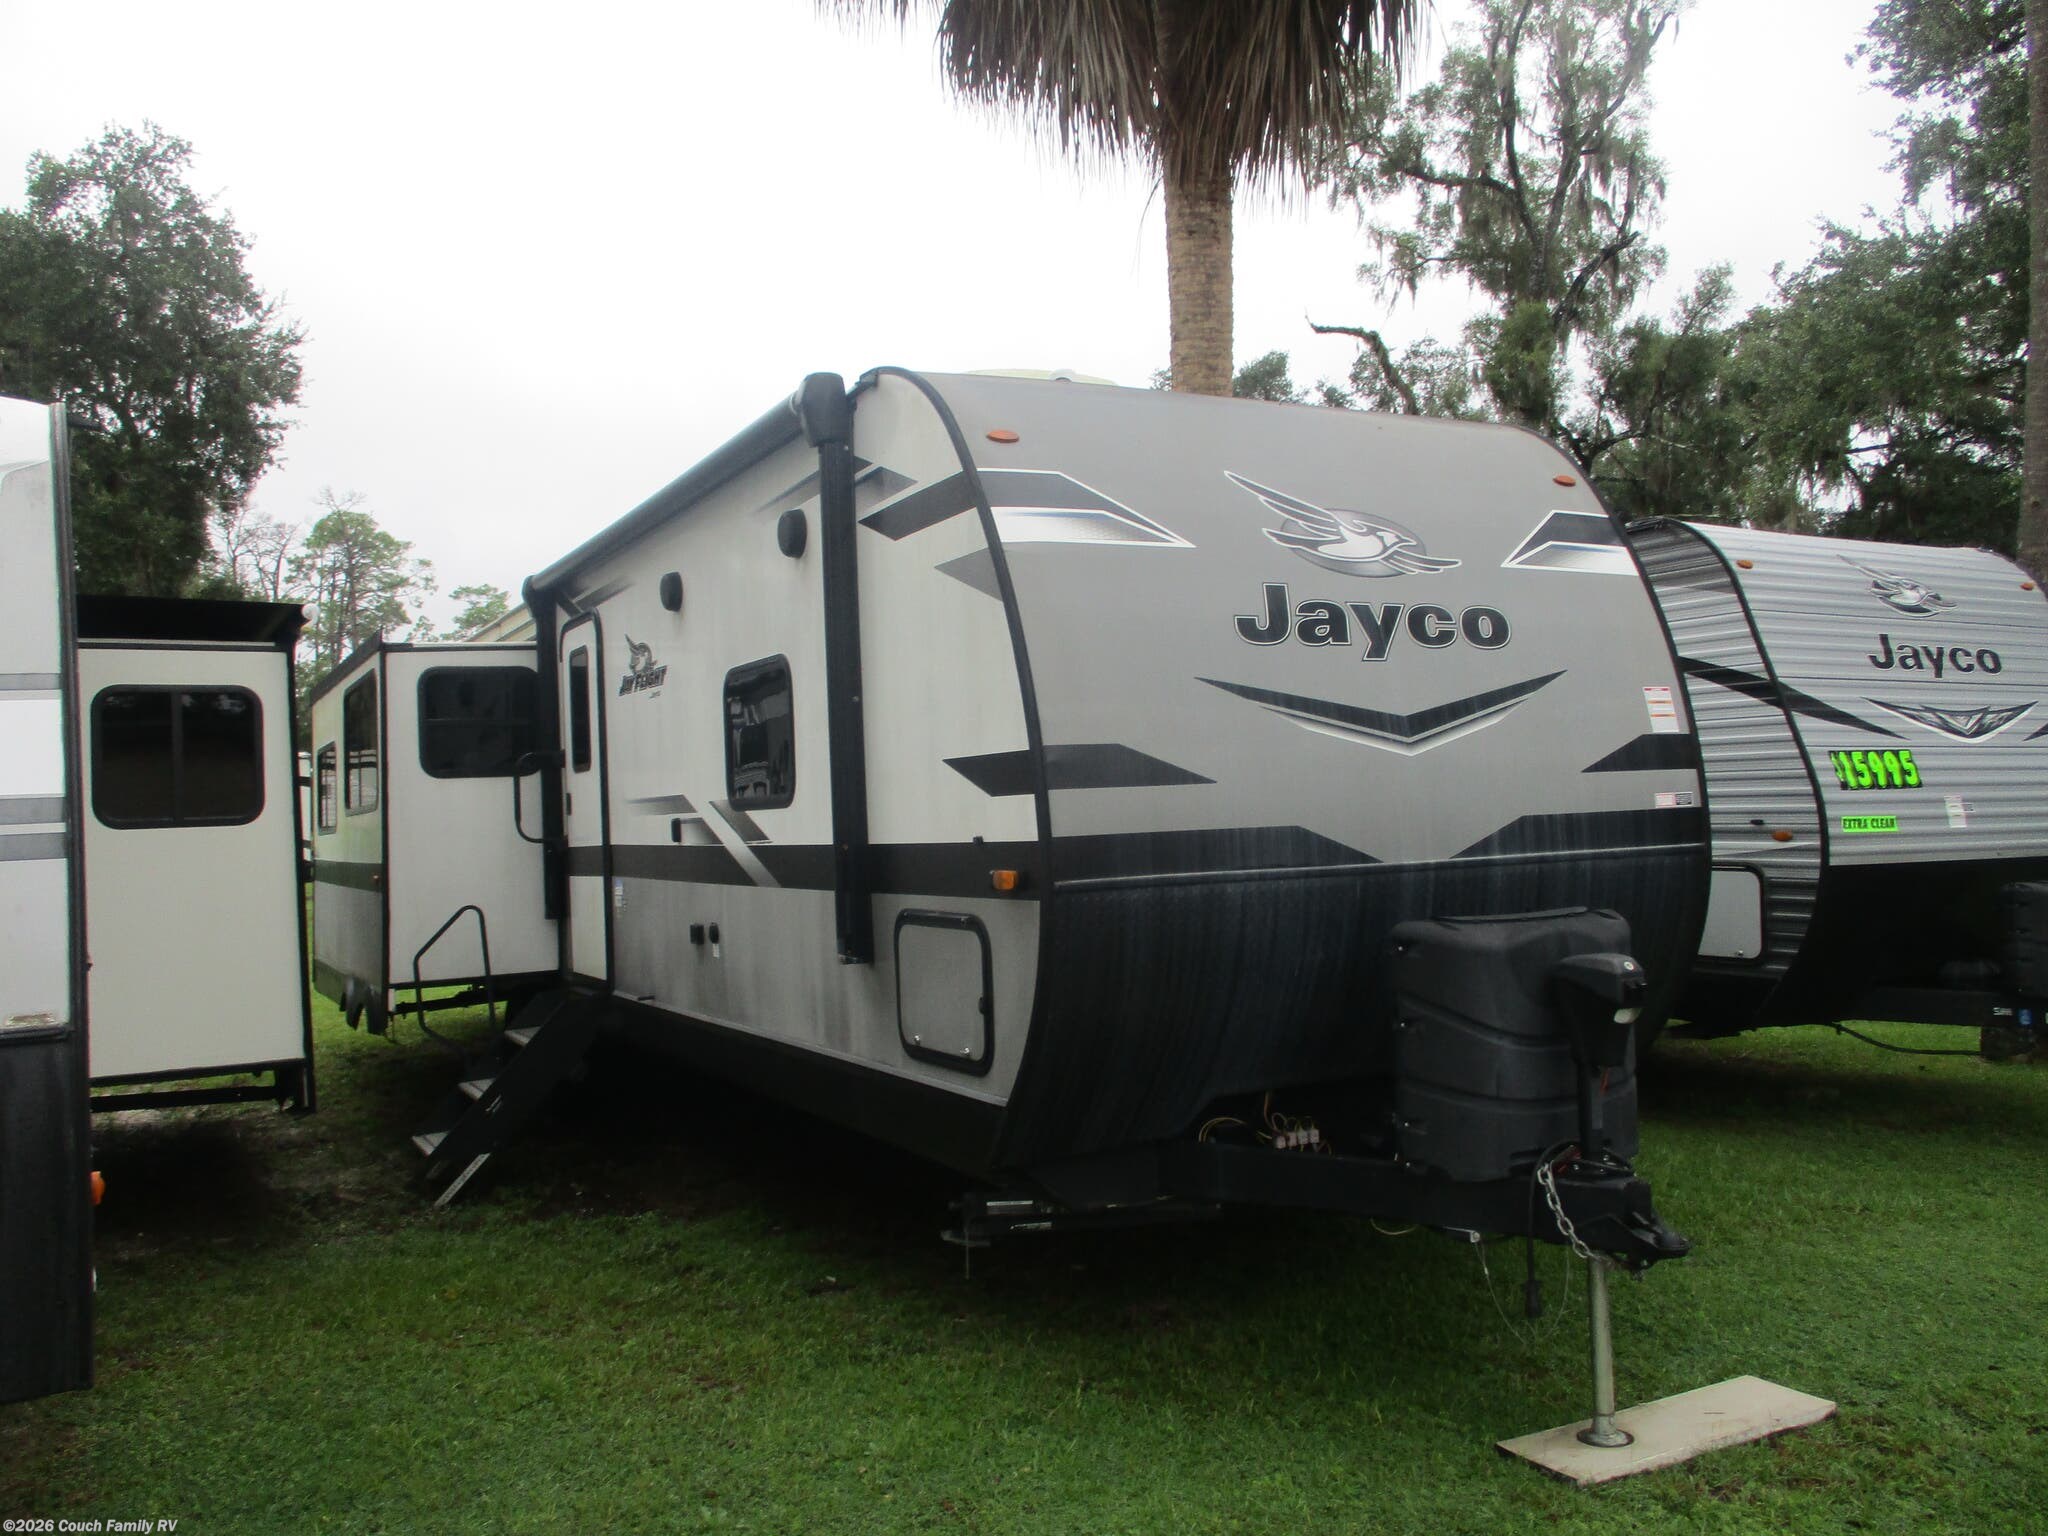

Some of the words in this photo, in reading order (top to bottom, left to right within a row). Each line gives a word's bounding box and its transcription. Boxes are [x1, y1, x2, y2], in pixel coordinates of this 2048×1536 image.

[1233, 582, 1512, 662] Jayco
[1867, 633, 2002, 679] Jayco
[1842, 818, 1868, 830] EXTRA
